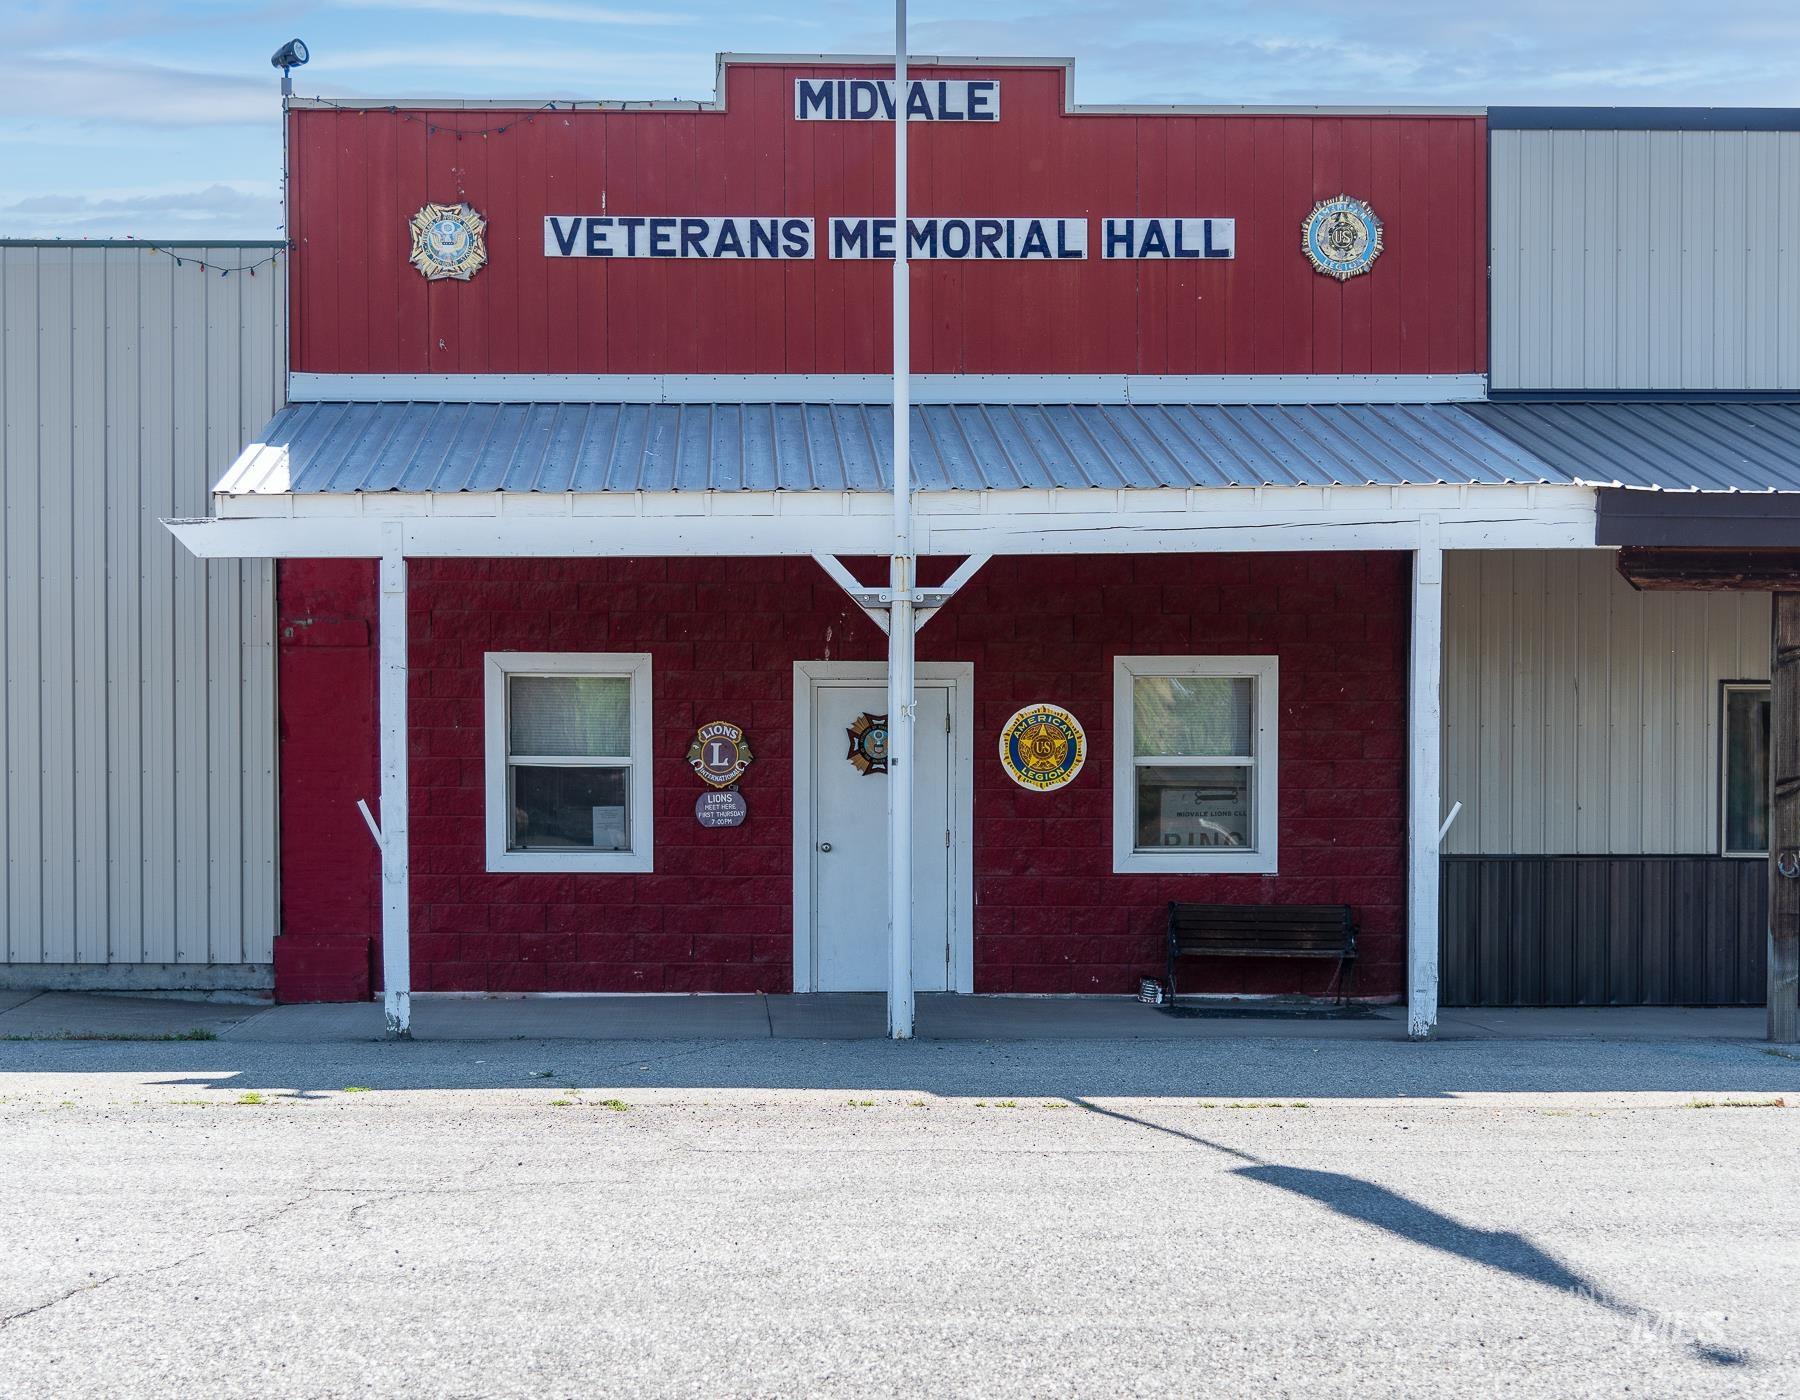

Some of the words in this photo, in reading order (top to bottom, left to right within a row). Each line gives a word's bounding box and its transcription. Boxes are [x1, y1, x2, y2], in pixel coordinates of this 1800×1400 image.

[800, 80, 995, 120] MIDVALE
[549, 217, 810, 258] VETERANS
[834, 219, 1083, 259] MEMORIAL
[1107, 219, 1231, 259] HALL
[702, 725, 739, 740] LIONS
[1013, 715, 1074, 739] AMERICAN
[710, 743, 729, 766] L
[699, 768, 741, 782] INTERNATIONAL
[1021, 767, 1065, 781] LEGION
[707, 794, 733, 803] LIONS
[716, 810, 745, 818] THURSDAY
